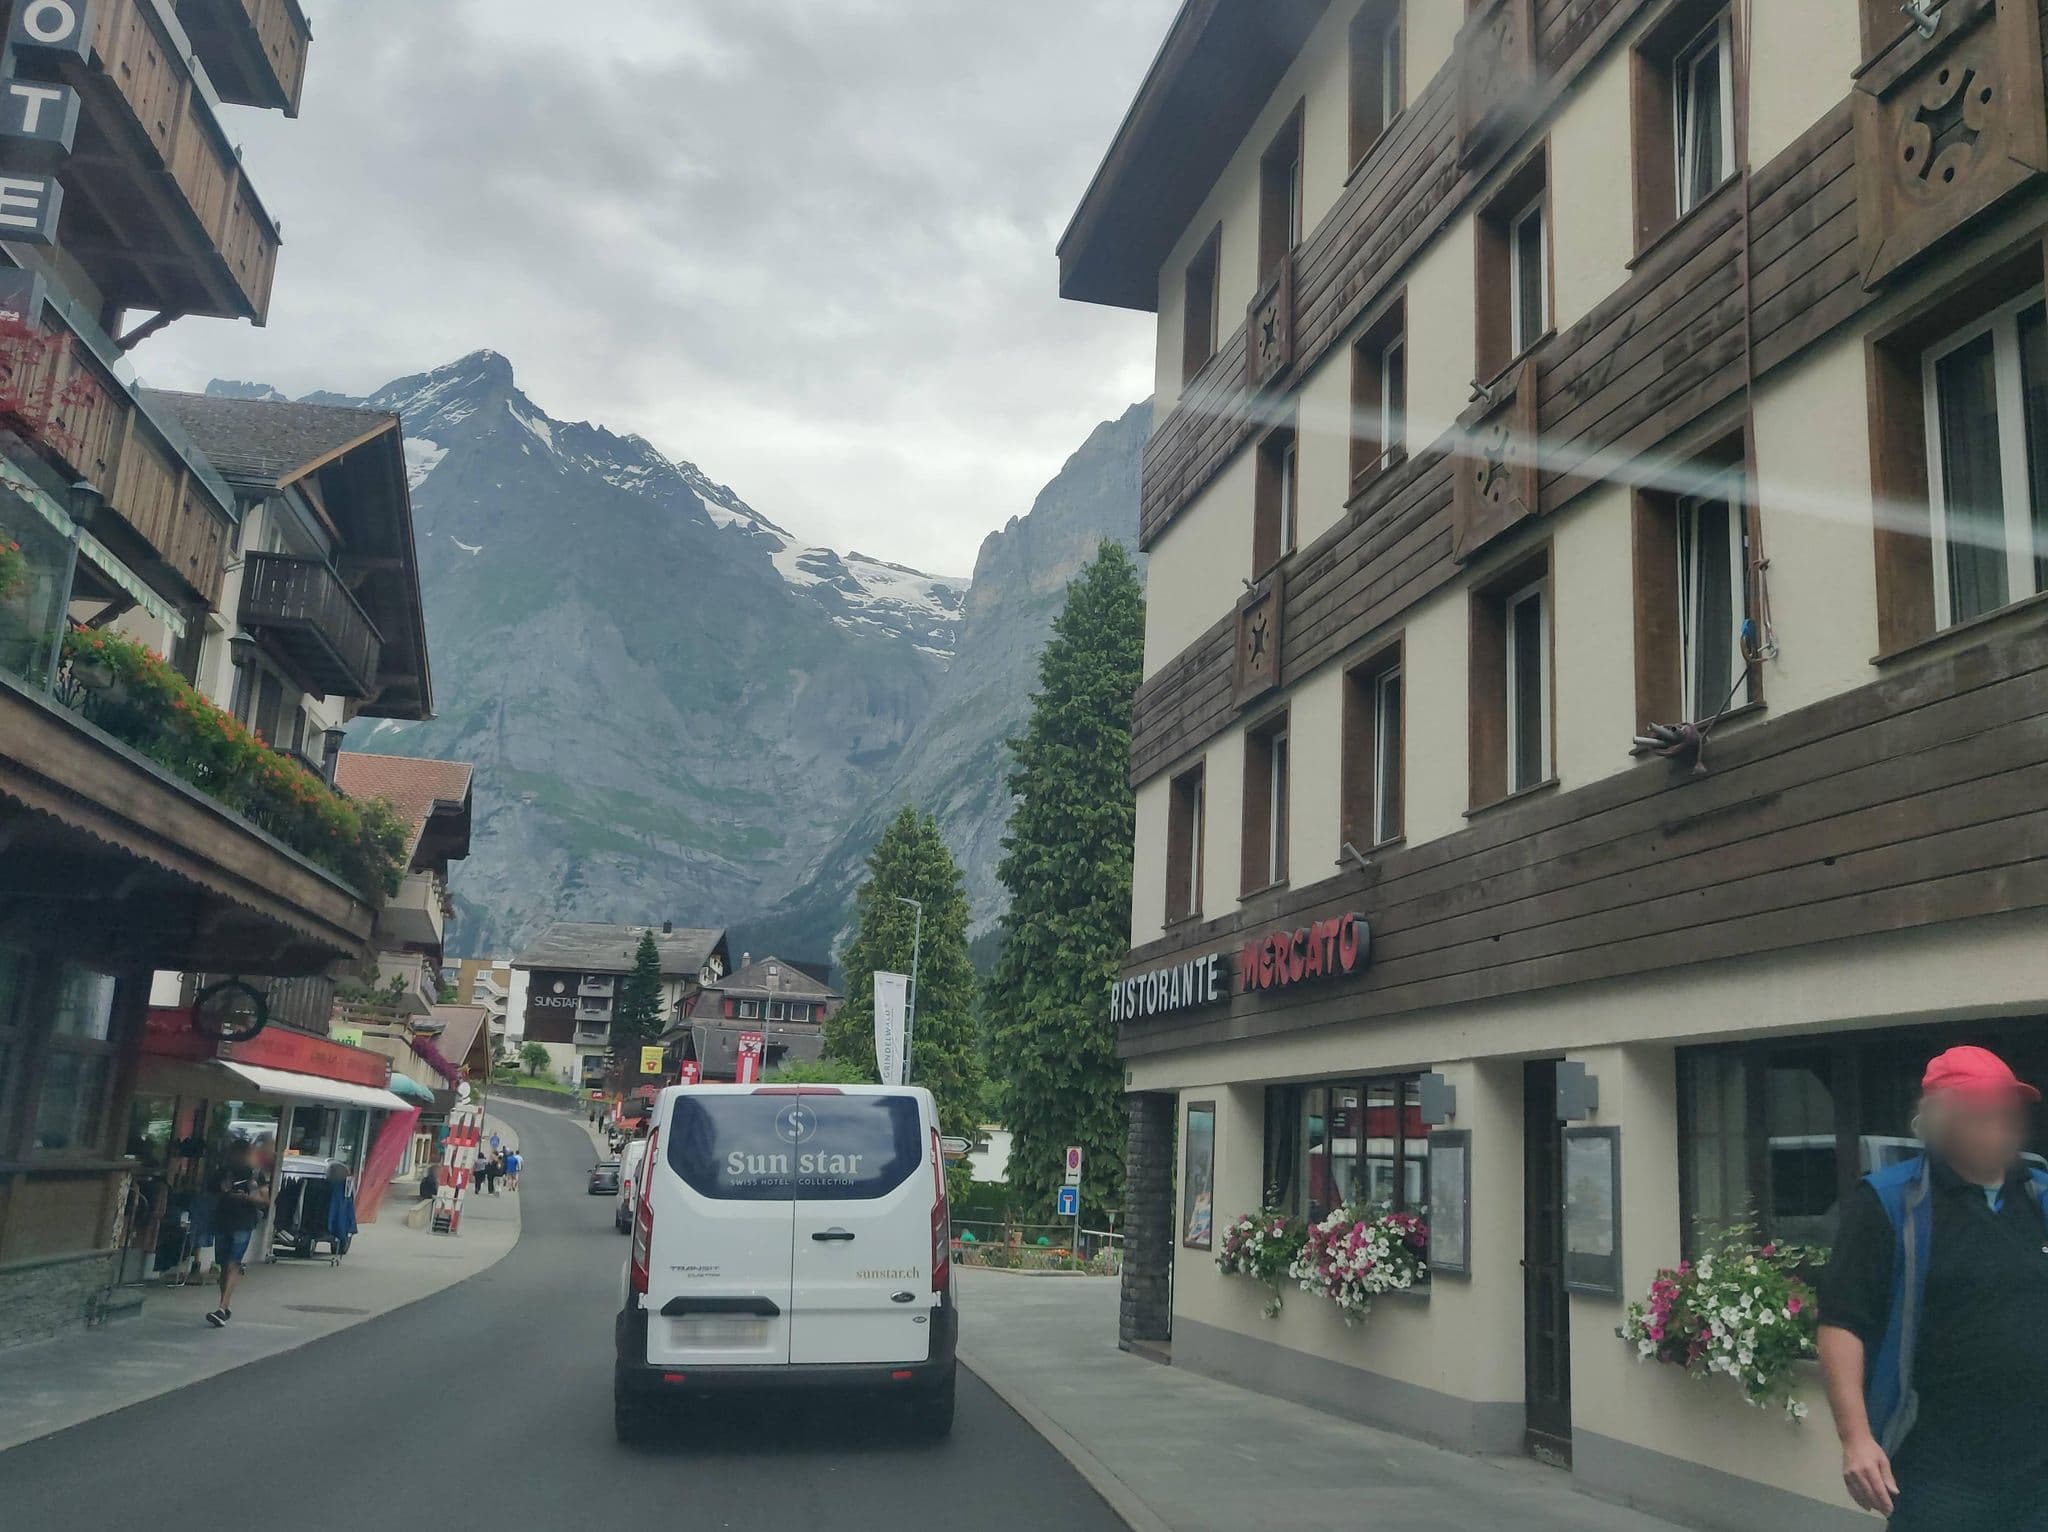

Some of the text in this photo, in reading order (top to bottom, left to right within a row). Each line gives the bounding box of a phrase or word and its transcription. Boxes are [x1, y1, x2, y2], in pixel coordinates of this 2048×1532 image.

[1110, 912, 1358, 1022] RISTORANTE MERCATO
[534, 996, 578, 1008] SUNSTAR
[883, 1009, 893, 1079] GRINDELWALD
[788, 1111, 804, 1136] S
[727, 1150, 863, 1175] Sun star
[730, 1178, 855, 1186] SWISS HOTEL COLLECTION
[856, 1266, 920, 1279] sunstar.ch
